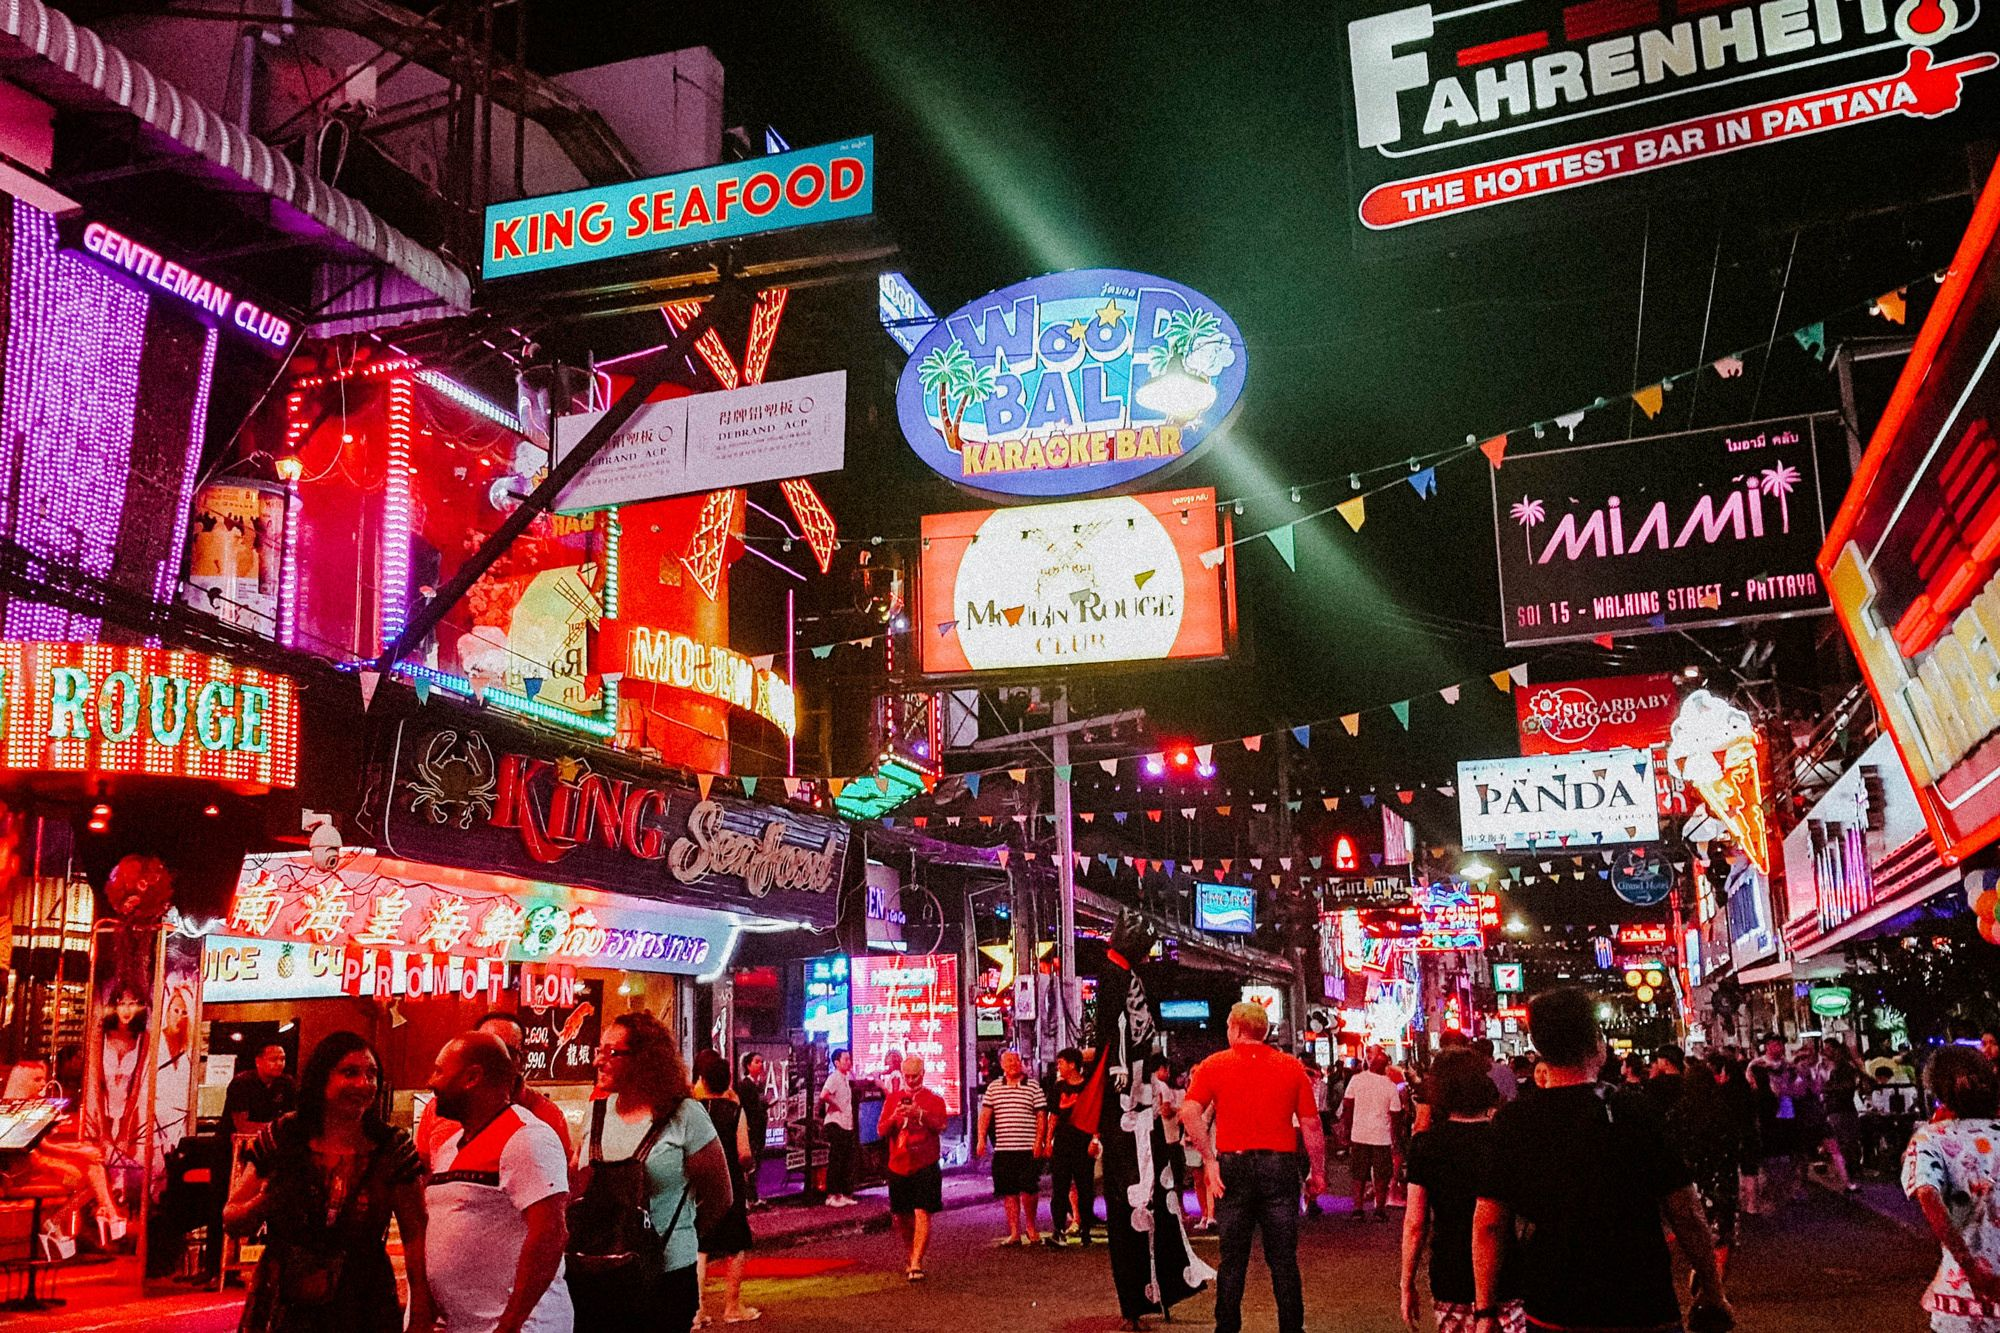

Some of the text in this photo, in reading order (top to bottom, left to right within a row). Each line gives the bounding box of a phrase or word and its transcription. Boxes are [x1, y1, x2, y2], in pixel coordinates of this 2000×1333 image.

[1349, 0, 1886, 148] FAHRENHEIT
[1402, 81, 1918, 213] THE HOTTEST BAR IN PATTAYA
[493, 157, 866, 262] KING SEAFOOD
[83, 221, 291, 349] GENTLEMAN CLUB
[947, 286, 1193, 370] WOOD
[984, 362, 1172, 440] BALL
[645, 447, 667, 458] ACP
[718, 424, 776, 441] DEBRAND
[784, 418, 808, 431] ACP
[962, 426, 1183, 477] KARAOKE BAR
[1538, 476, 1764, 565] MIAMI
[967, 591, 1174, 631] MULIN ROUGE
[1517, 605, 1541, 628] SOI
[1550, 601, 1570, 625] 15
[1668, 583, 1722, 611] STREET
[1747, 573, 1817, 602] PATTAYA
[1035, 633, 1105, 655] CLUB
[49, 666, 270, 753] ROUGE
[1560, 711, 1637, 731] AGO-GO
[1562, 694, 1672, 716] SUGARBABY
[1478, 779, 1636, 817] PANDA
[867, 886, 885, 919] EN
